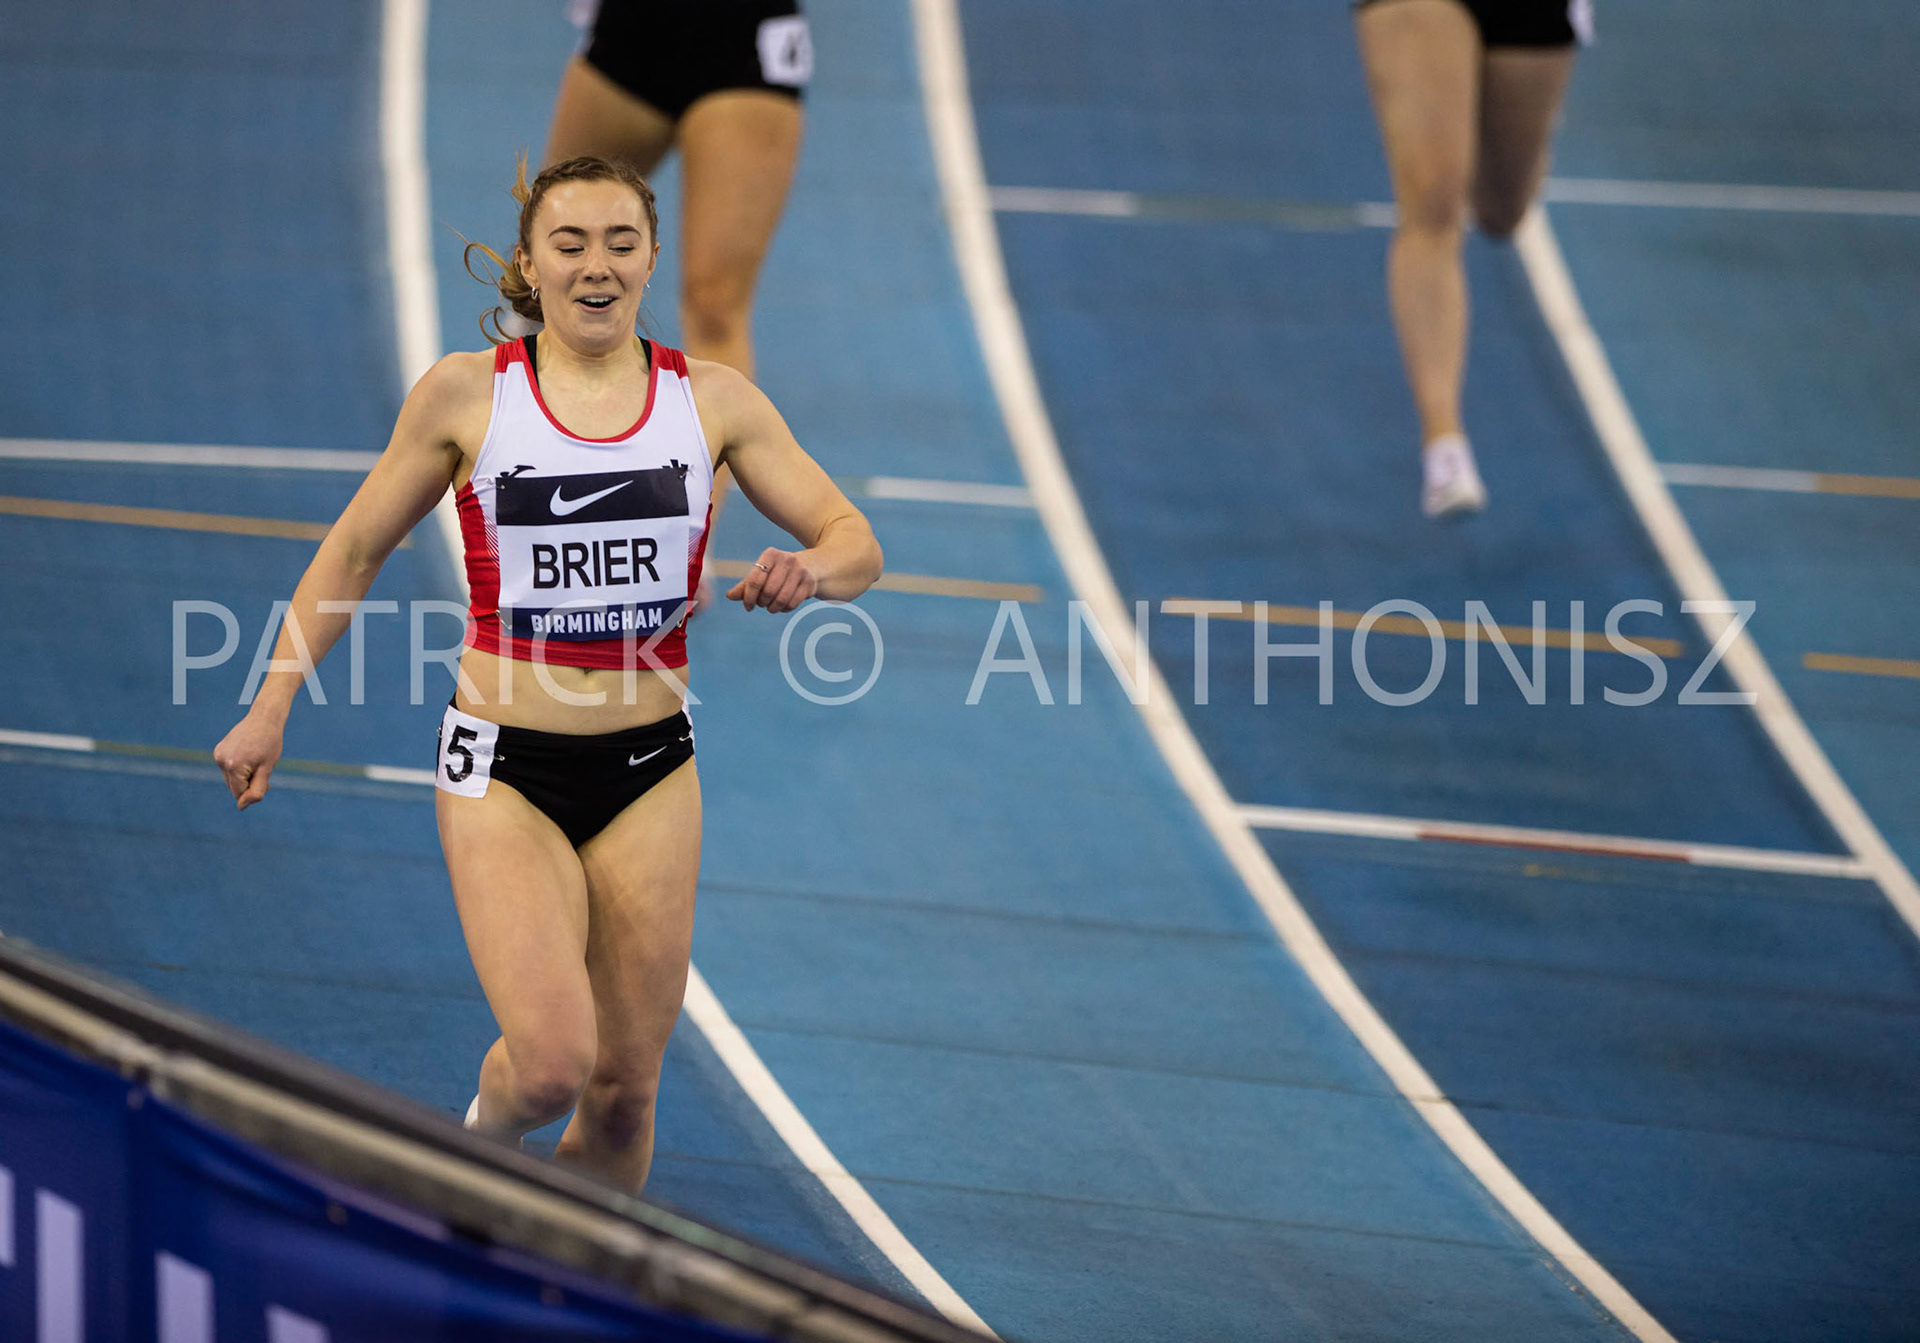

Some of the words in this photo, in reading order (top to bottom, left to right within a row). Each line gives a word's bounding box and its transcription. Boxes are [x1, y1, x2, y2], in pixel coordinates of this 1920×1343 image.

[532, 538, 660, 589] BRIER
[531, 608, 663, 633] BIRMINGHAM
[445, 725, 478, 783] 5
